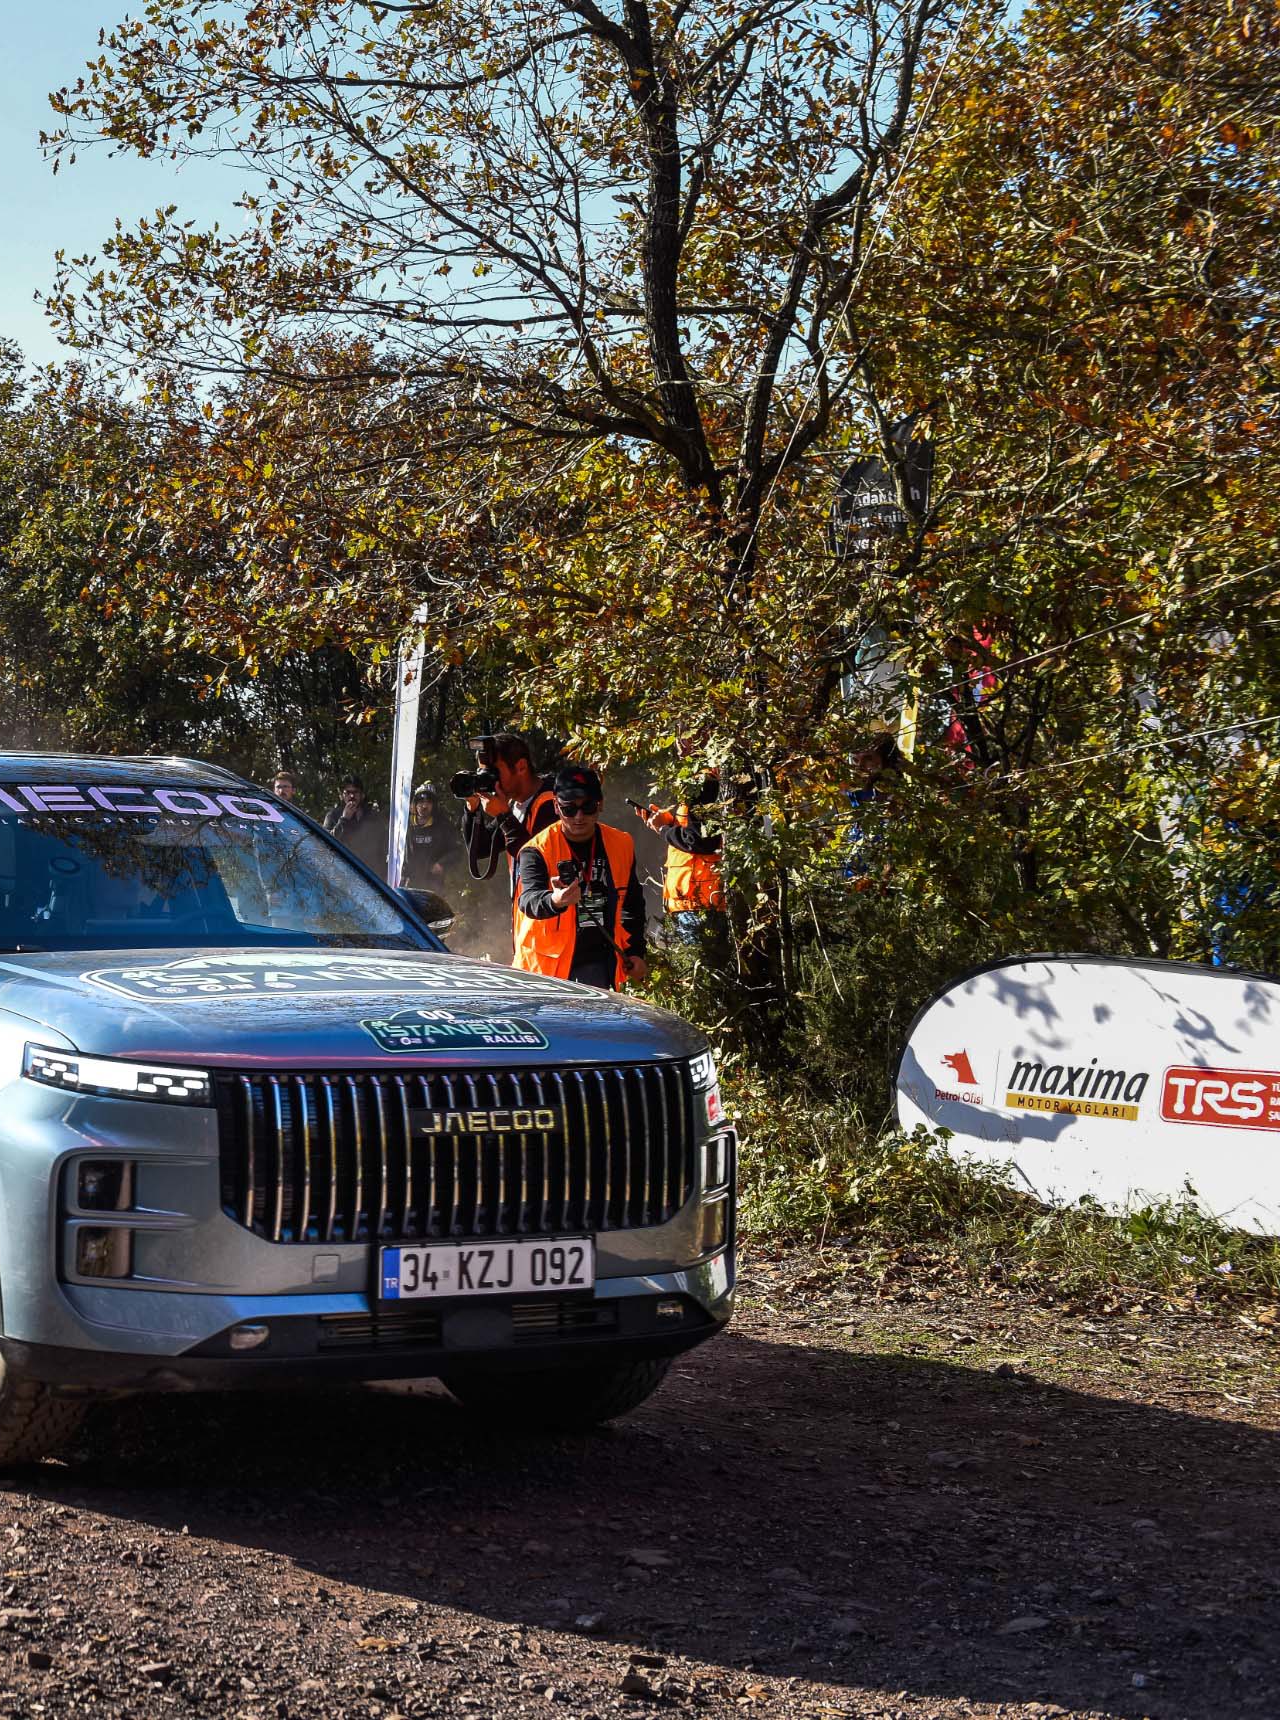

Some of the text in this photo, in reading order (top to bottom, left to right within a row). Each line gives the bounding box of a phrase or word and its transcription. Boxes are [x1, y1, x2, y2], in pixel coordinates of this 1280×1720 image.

[103, 817, 191, 827] BEYOND
[209, 820, 300, 836] CLASSIC
[417, 1010, 455, 1020] 00
[1007, 1057, 1150, 1103] maxima
[935, 1088, 984, 1105] Petrol Ofisi
[1017, 1096, 1128, 1118] MOTOR YAĞLARI
[1168, 1077, 1268, 1120] TRS
[421, 1109, 555, 1133] JAECOO
[403, 1246, 585, 1292] 34 KZJ 092
[384, 1277, 399, 1289] TR
